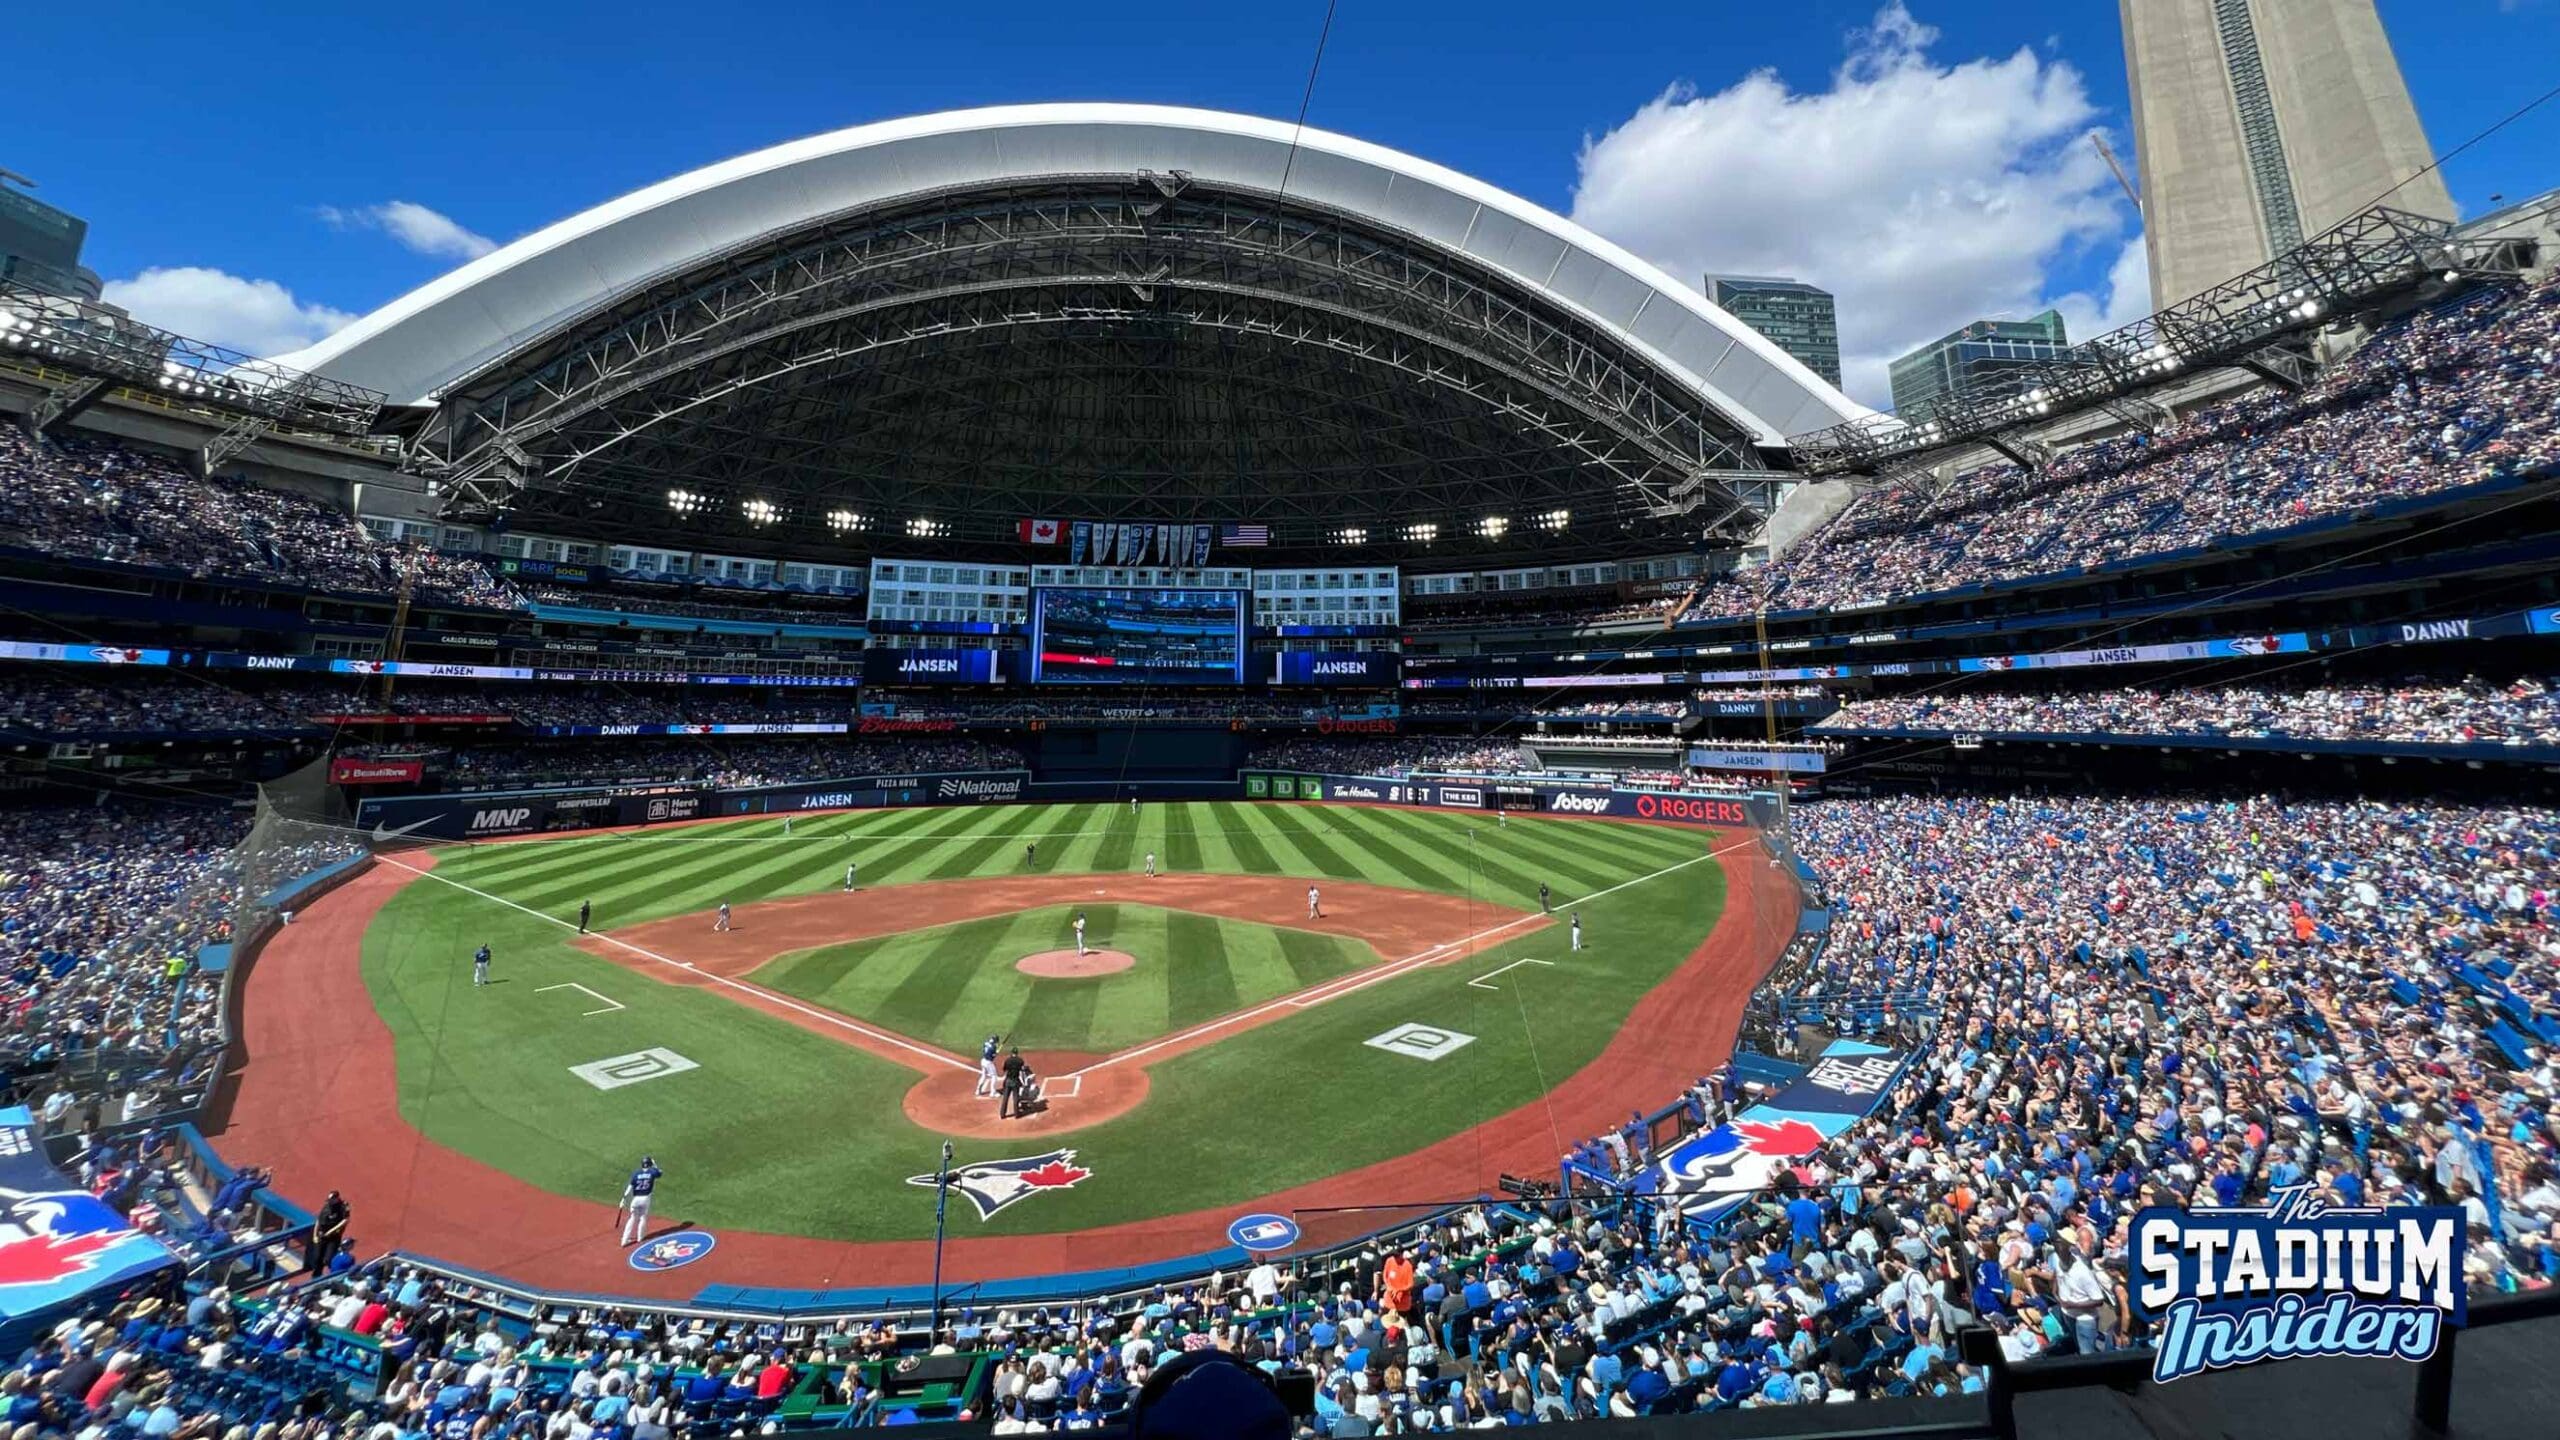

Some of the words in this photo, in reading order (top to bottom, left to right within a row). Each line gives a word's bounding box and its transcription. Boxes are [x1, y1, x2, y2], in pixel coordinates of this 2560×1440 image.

[2402, 619, 2469, 641] DANNY
[441, 635, 467, 645] CARLOS
[469, 637, 498, 646] DELGADO
[2089, 649, 2137, 663] JANSEN
[247, 656, 295, 670] DANNY
[898, 658, 958, 672] JANSEN
[1313, 661, 1367, 673] JANSEN
[430, 665, 474, 676] JANSEN
[1748, 671, 1776, 680] DANNY
[1871, 664, 1909, 675] JANSEN
[1102, 708, 1145, 717] WESTJET
[1720, 703, 1755, 714] DANNY
[601, 725, 640, 735] DANNY
[753, 724, 793, 733] JANSEN
[1336, 719, 1398, 733] ROGERS
[1724, 755, 1763, 766] JANSEN
[1897, 762, 1945, 774] TORONTO
[876, 779, 897, 789] PIZZA
[898, 778, 918, 788] NOVA
[958, 778, 1021, 795] National
[1251, 779, 1266, 793] TD
[1276, 780, 1292, 793] TD
[1301, 781, 1318, 794] TD
[1333, 785, 1348, 797] Tim
[1348, 786, 1379, 798] Hortons
[1444, 793, 1460, 801] THE
[1461, 793, 1477, 801] KEG
[670, 799, 698, 809] Here's
[801, 793, 852, 808] JANSEN
[1551, 792, 1610, 813] Sobeys
[1660, 798, 1745, 823] ROGERS
[472, 808, 530, 829] MNP
